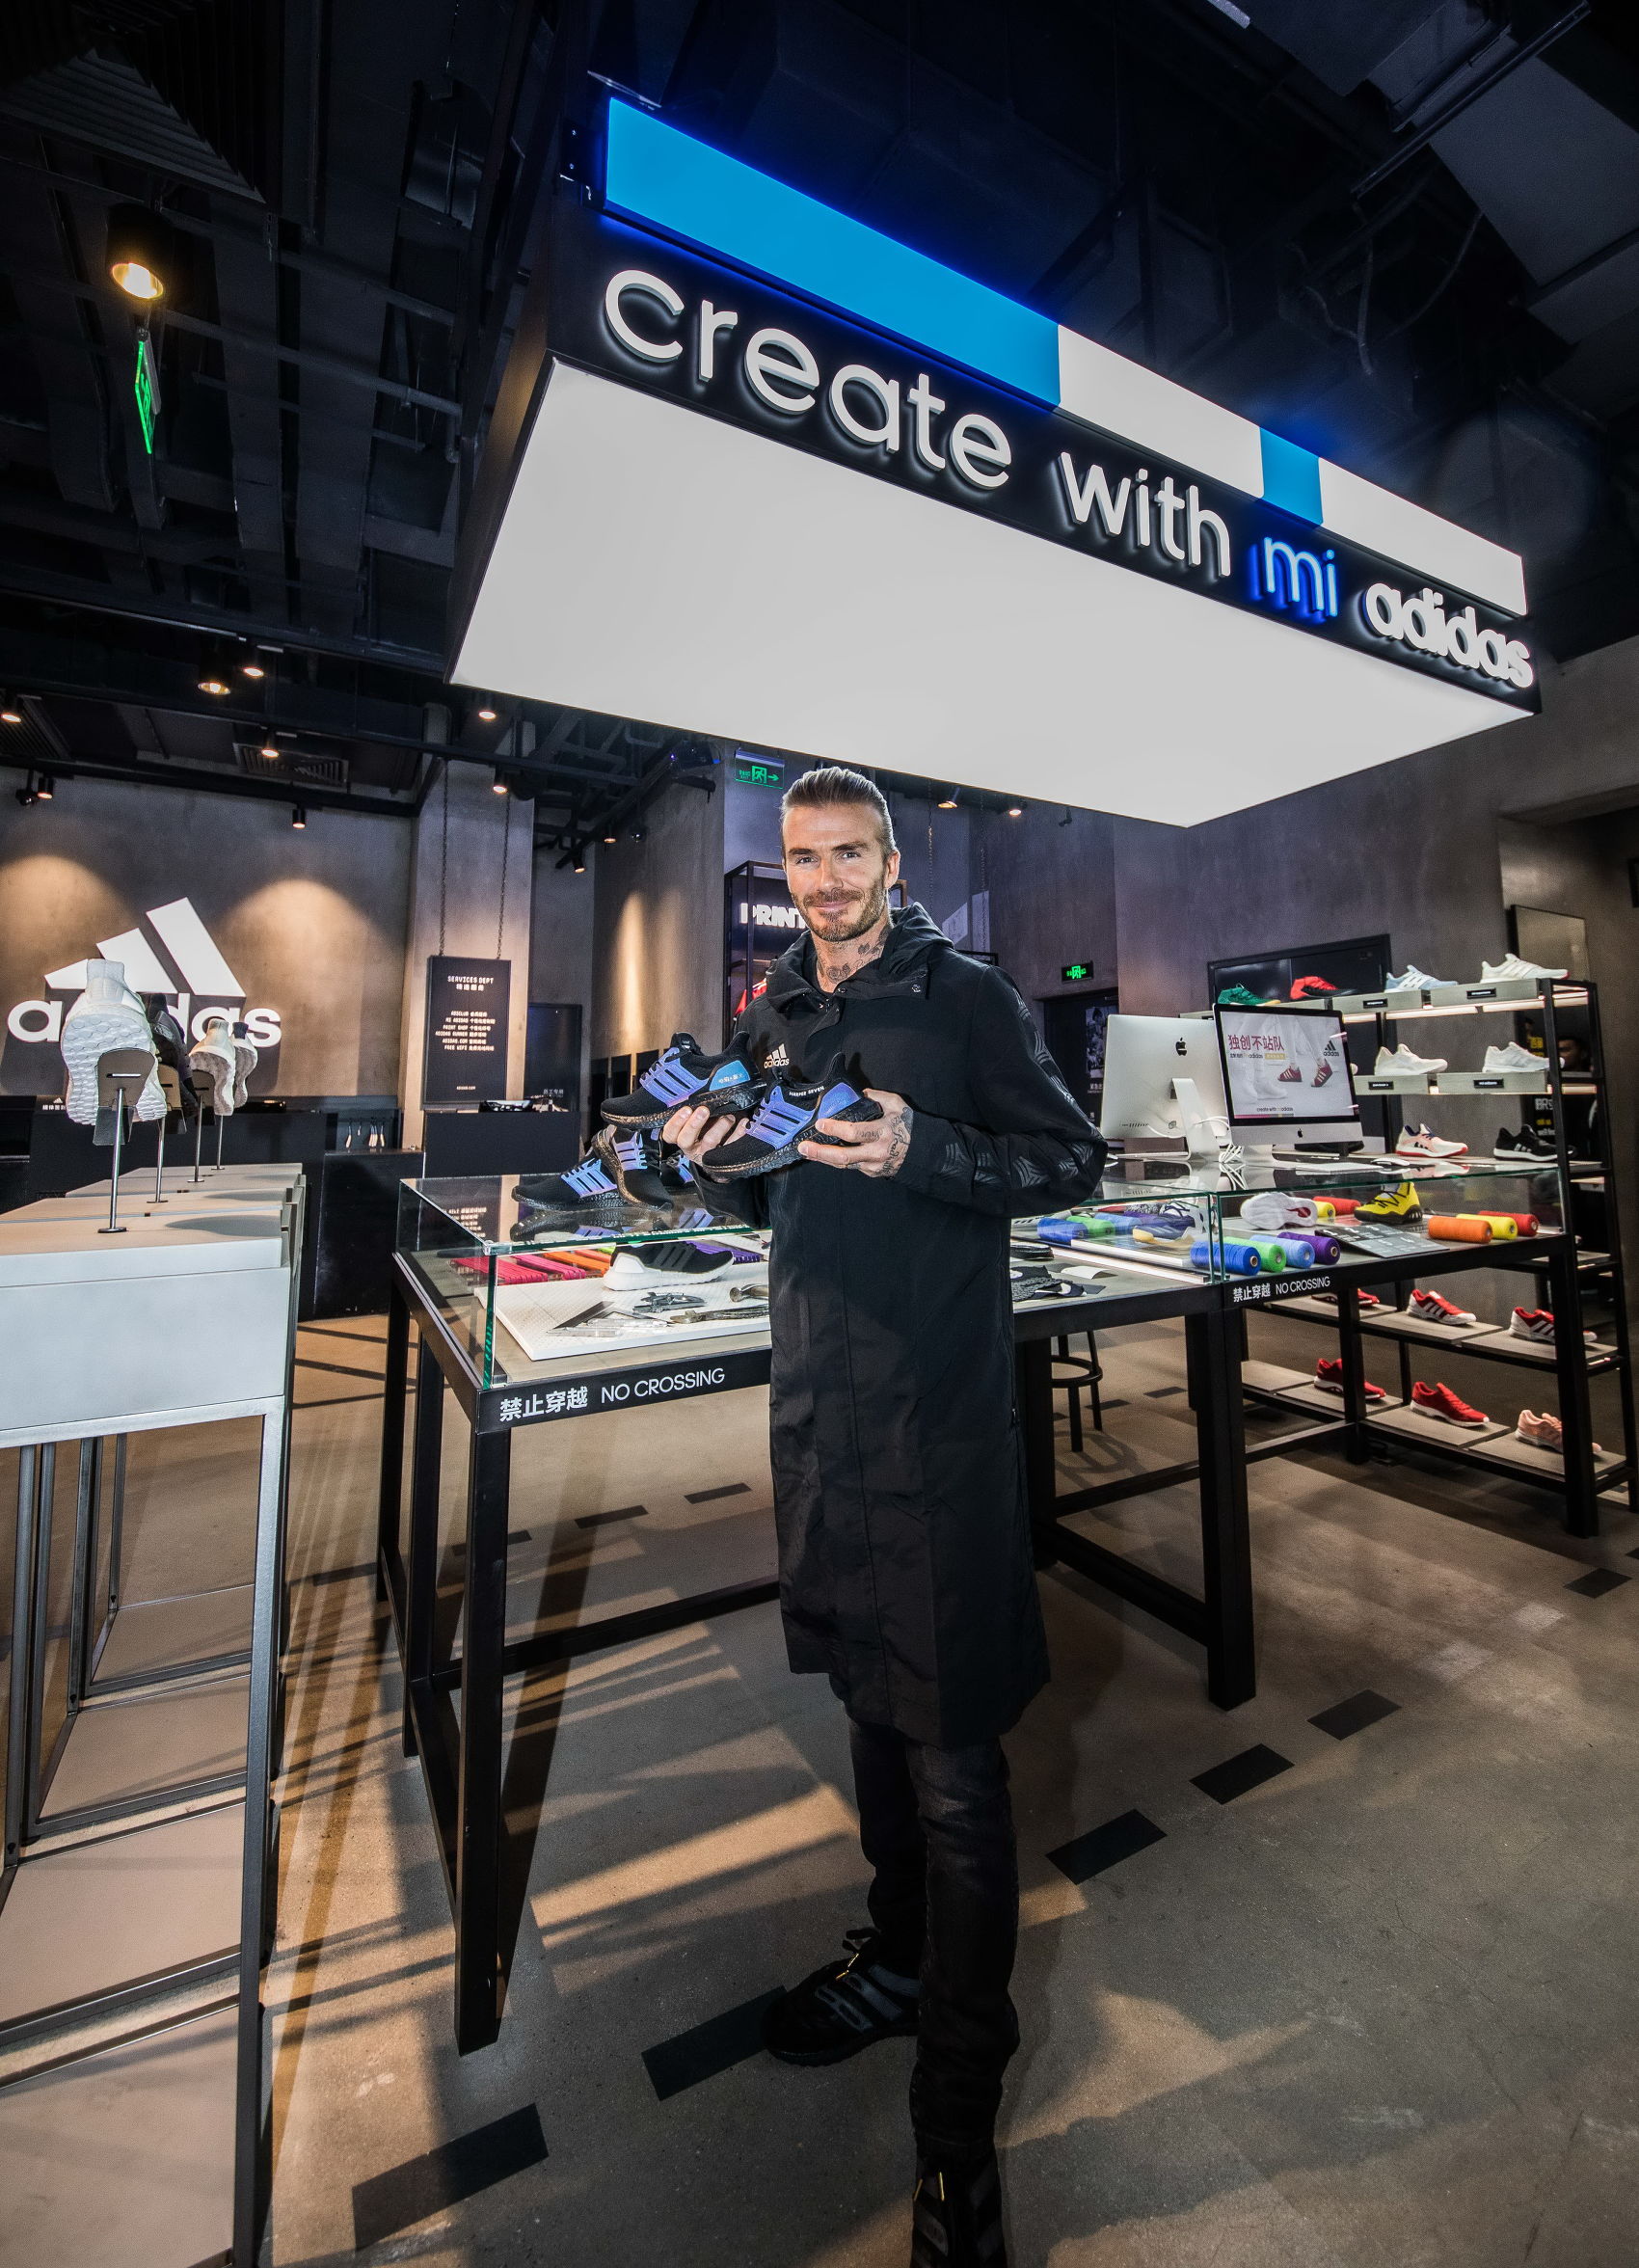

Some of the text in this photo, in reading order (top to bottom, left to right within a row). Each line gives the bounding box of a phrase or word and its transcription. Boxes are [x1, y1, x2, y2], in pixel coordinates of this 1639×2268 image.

[605, 269, 1534, 688] create with mi adidas
[8, 993, 282, 1048] adas
[1228, 1035, 1284, 1051] 独创不站队
[764, 1058, 790, 1069] adidas
[808, 1086, 825, 1094] SEVEN
[1233, 1276, 1330, 1302] 禁止穿越 NO CROSSING
[499, 1367, 725, 1422] 禁止穿越 NO CROSSING
